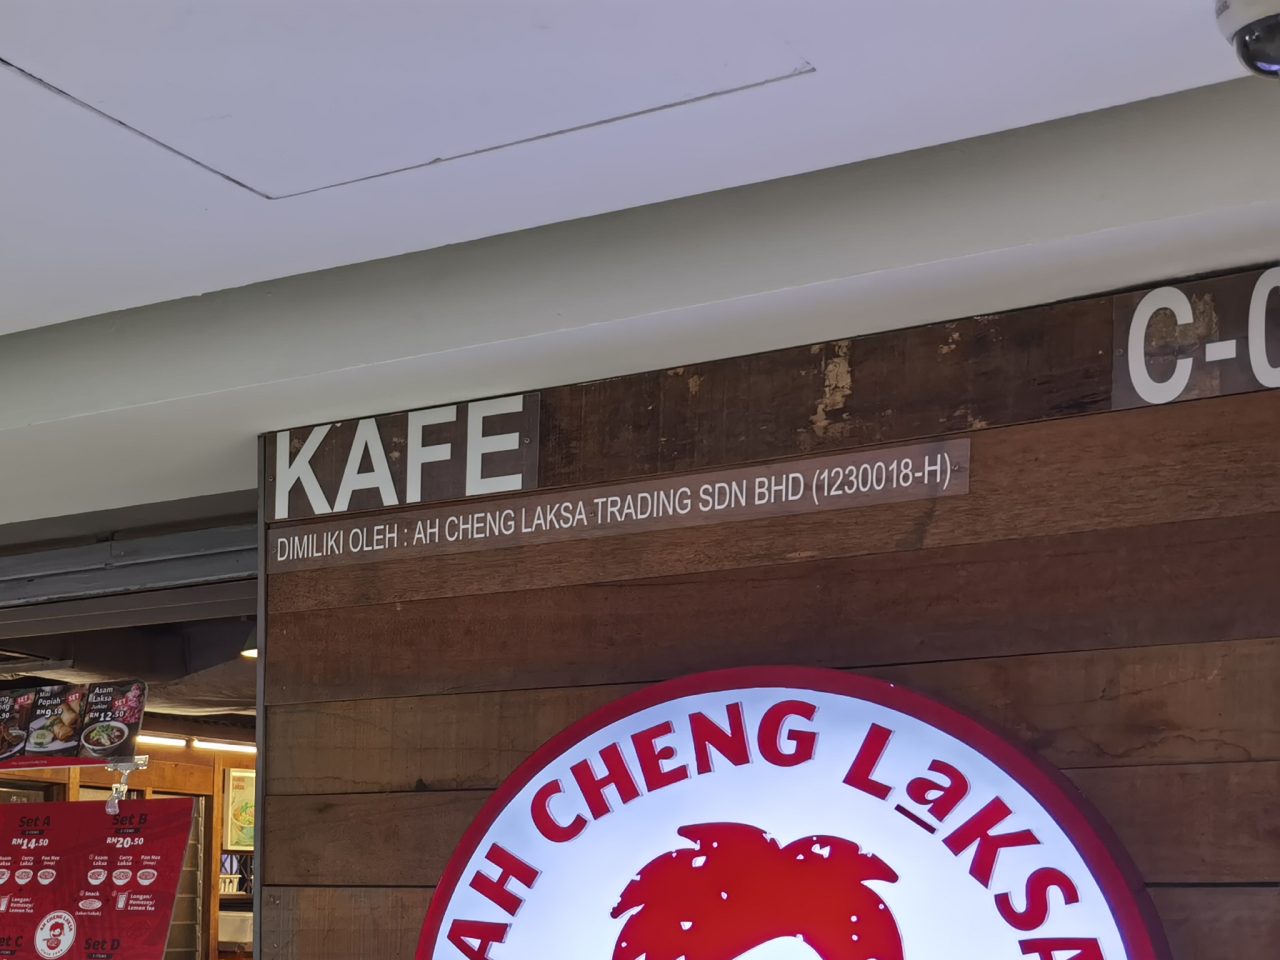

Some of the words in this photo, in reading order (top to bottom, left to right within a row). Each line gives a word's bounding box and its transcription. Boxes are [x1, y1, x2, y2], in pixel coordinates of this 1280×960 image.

[274, 394, 524, 520] KAFE
[276, 529, 344, 562] DIMILIKI
[349, 522, 398, 552] OLEH
[413, 516, 439, 546] AH
[444, 508, 516, 542] CHENG
[521, 499, 588, 534] LAKSA
[592, 486, 692, 525] TRADING
[698, 479, 747, 512] SDN
[754, 472, 805, 505] BHD
[811, 452, 952, 505] (1230018-H)
[94, 686, 114, 694] Asam
[17, 695, 28, 703] SET
[37, 696, 61, 706] Popiah
[68, 693, 80, 701] SET
[92, 694, 113, 703] Laksa
[114, 698, 127, 707] SET
[36, 709, 63, 718] RM9.50
[89, 710, 125, 721] RM12.50
[529, 698, 821, 843] CHENG
[19, 816, 39, 827] Set
[42, 816, 51, 826] A
[112, 814, 135, 825] Set
[12, 838, 49, 849] RM14.50
[106, 837, 144, 848] RM20.50
[15, 935, 23, 947] C
[84, 938, 107, 950] Set
[110, 938, 121, 950] D
